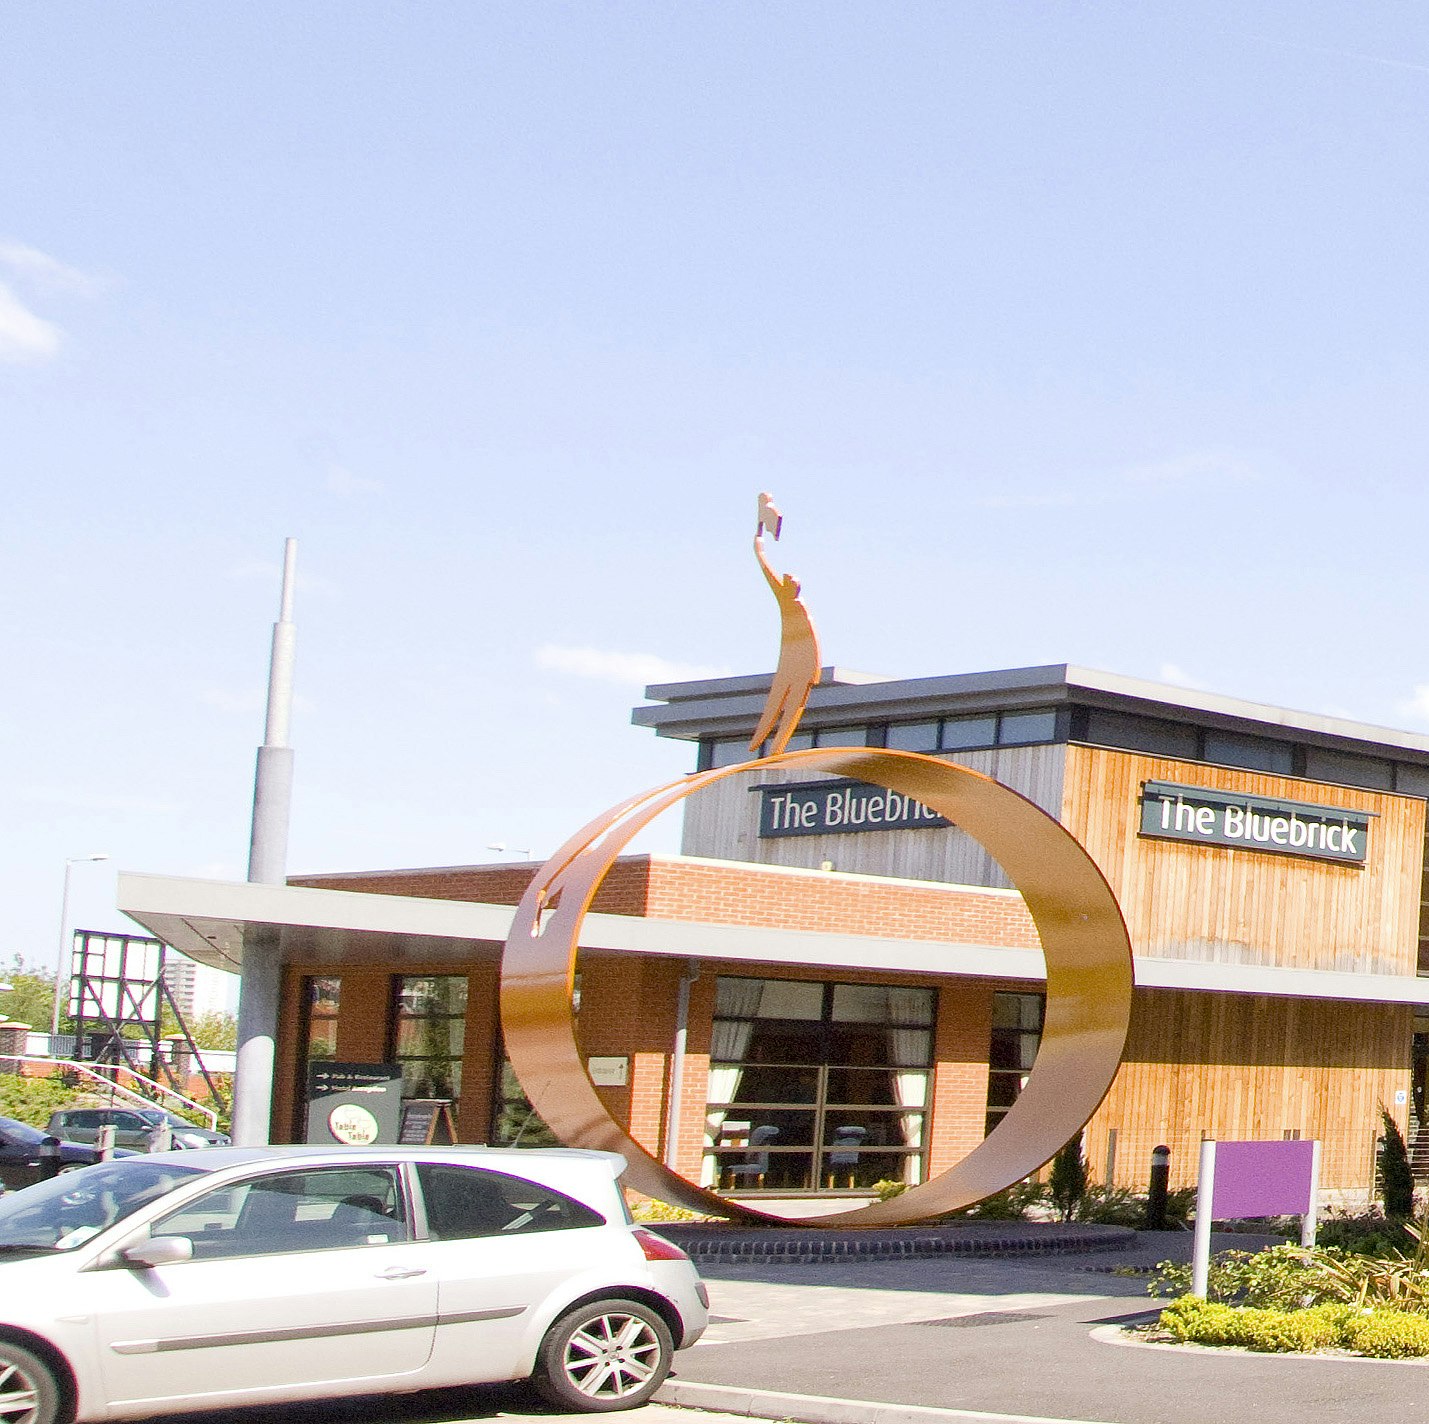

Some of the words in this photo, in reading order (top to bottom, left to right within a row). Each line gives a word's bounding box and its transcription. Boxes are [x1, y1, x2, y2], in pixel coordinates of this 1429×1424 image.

[770, 792, 818, 828] The
[824, 788, 942, 826] Bluebric
[1158, 793, 1215, 834] The
[1223, 803, 1357, 853] Bluebrick
[349, 1129, 370, 1141] Table
